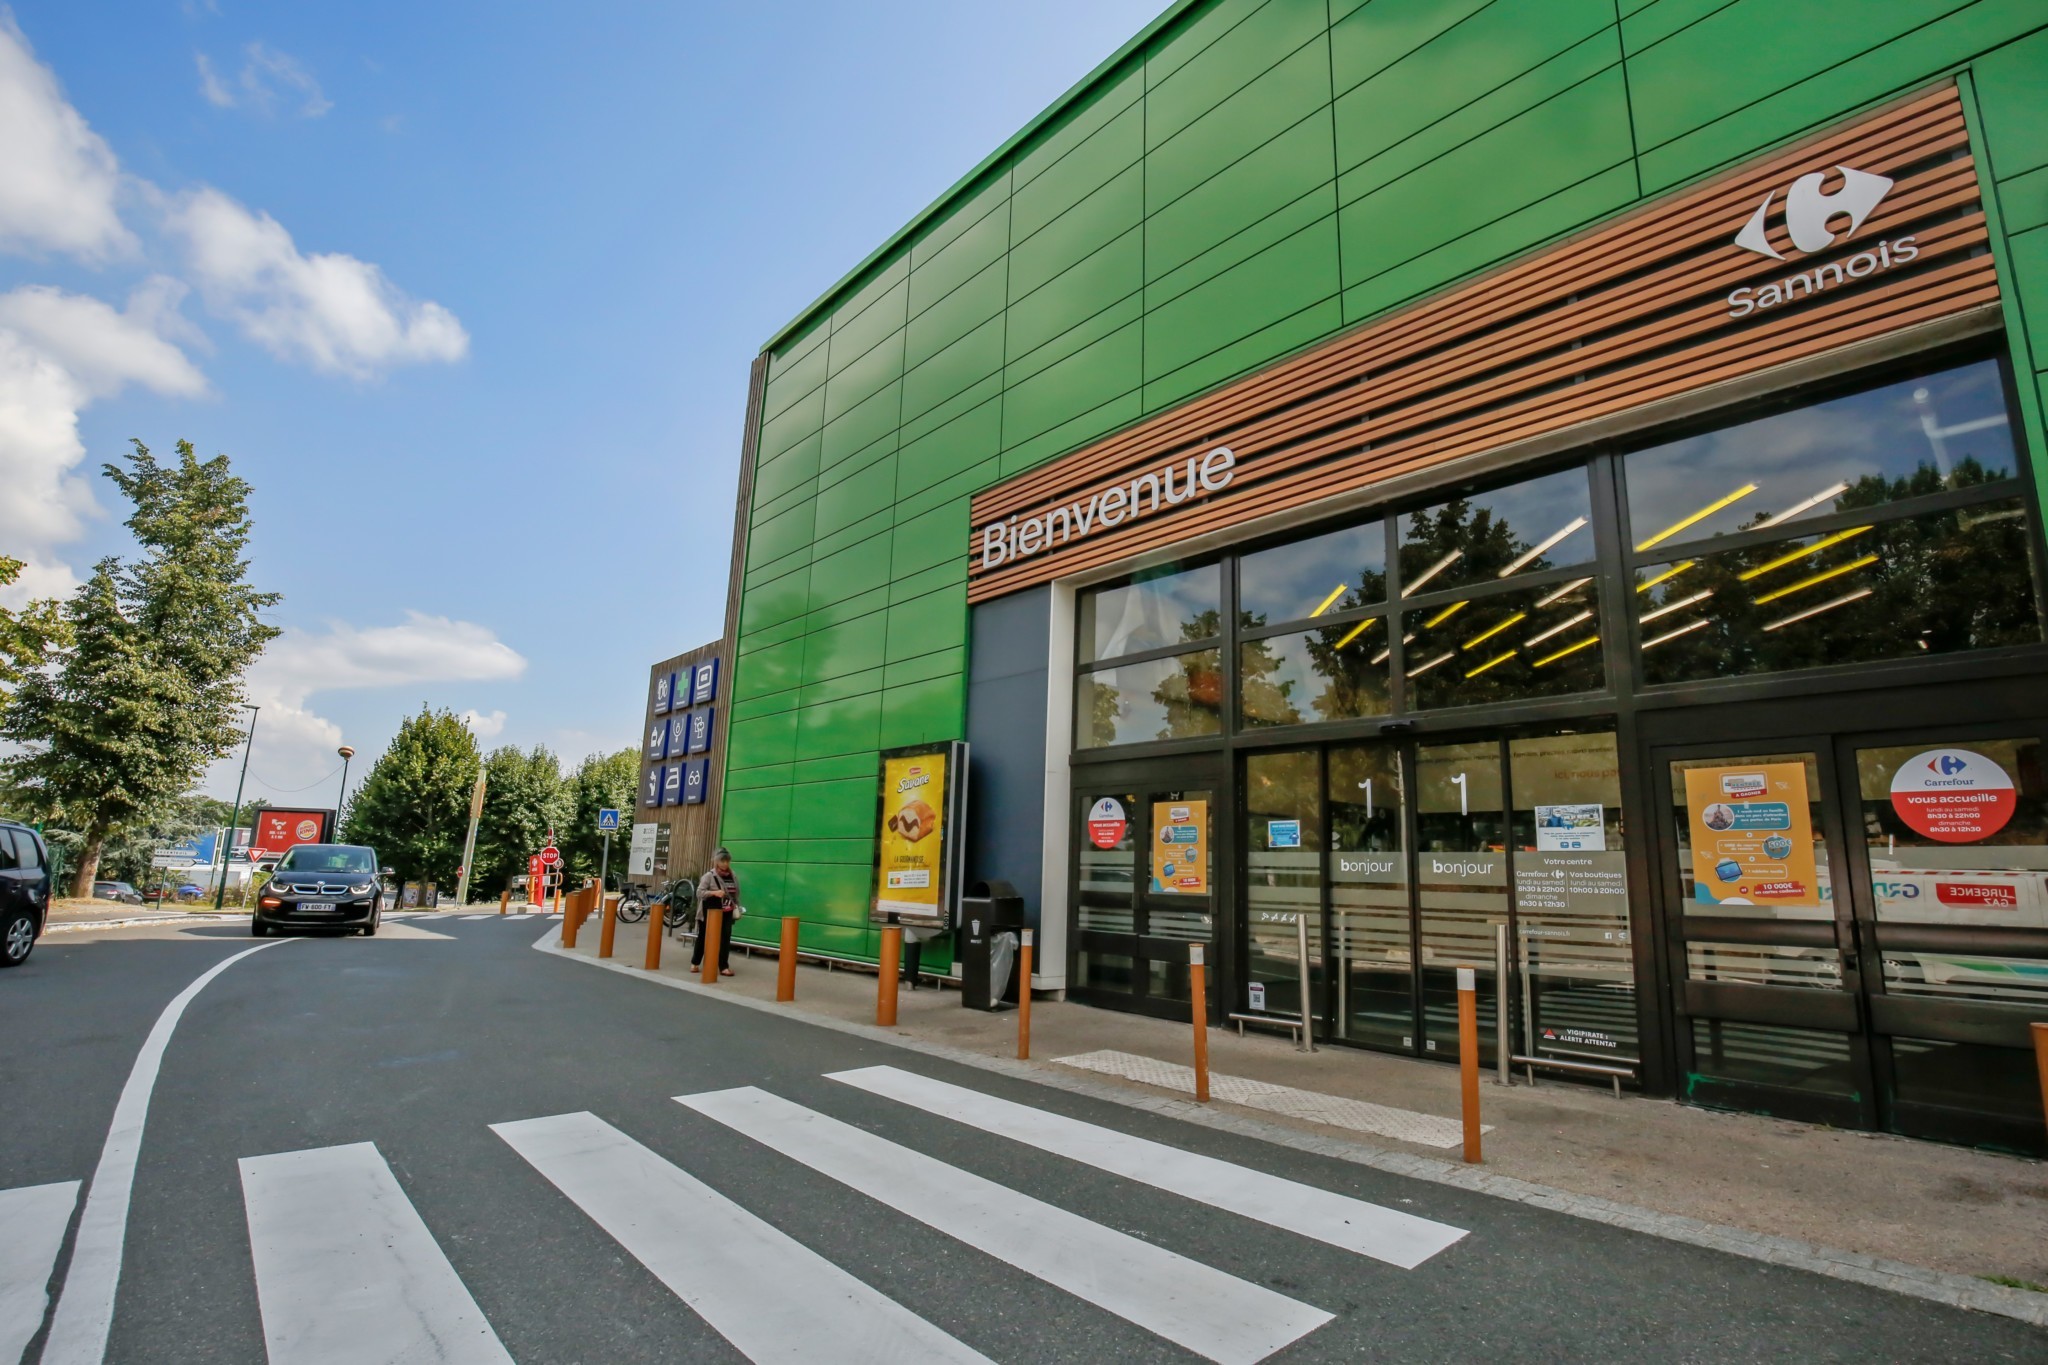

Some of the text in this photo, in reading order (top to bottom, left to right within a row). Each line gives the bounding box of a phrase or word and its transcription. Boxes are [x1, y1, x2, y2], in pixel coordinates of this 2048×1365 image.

[1727, 236, 1919, 318] Sannois
[982, 446, 1236, 569] Bienvenue
[897, 774, 930, 793] Savane
[1925, 778, 1974, 787] Carrefour
[1358, 778, 1372, 819] 1
[1451, 772, 1468, 816] 1
[1939, 793, 1998, 803] accueille
[1768, 838, 1793, 848] 500€
[1340, 858, 1394, 875] bonjour
[1433, 859, 1494, 877] bonjour
[1584, 871, 1622, 879] boutiques
[1560, 1035, 1617, 1048] ALERTE ATTENTAT
[1566, 1028, 1604, 1039] VIGIPIRATE
